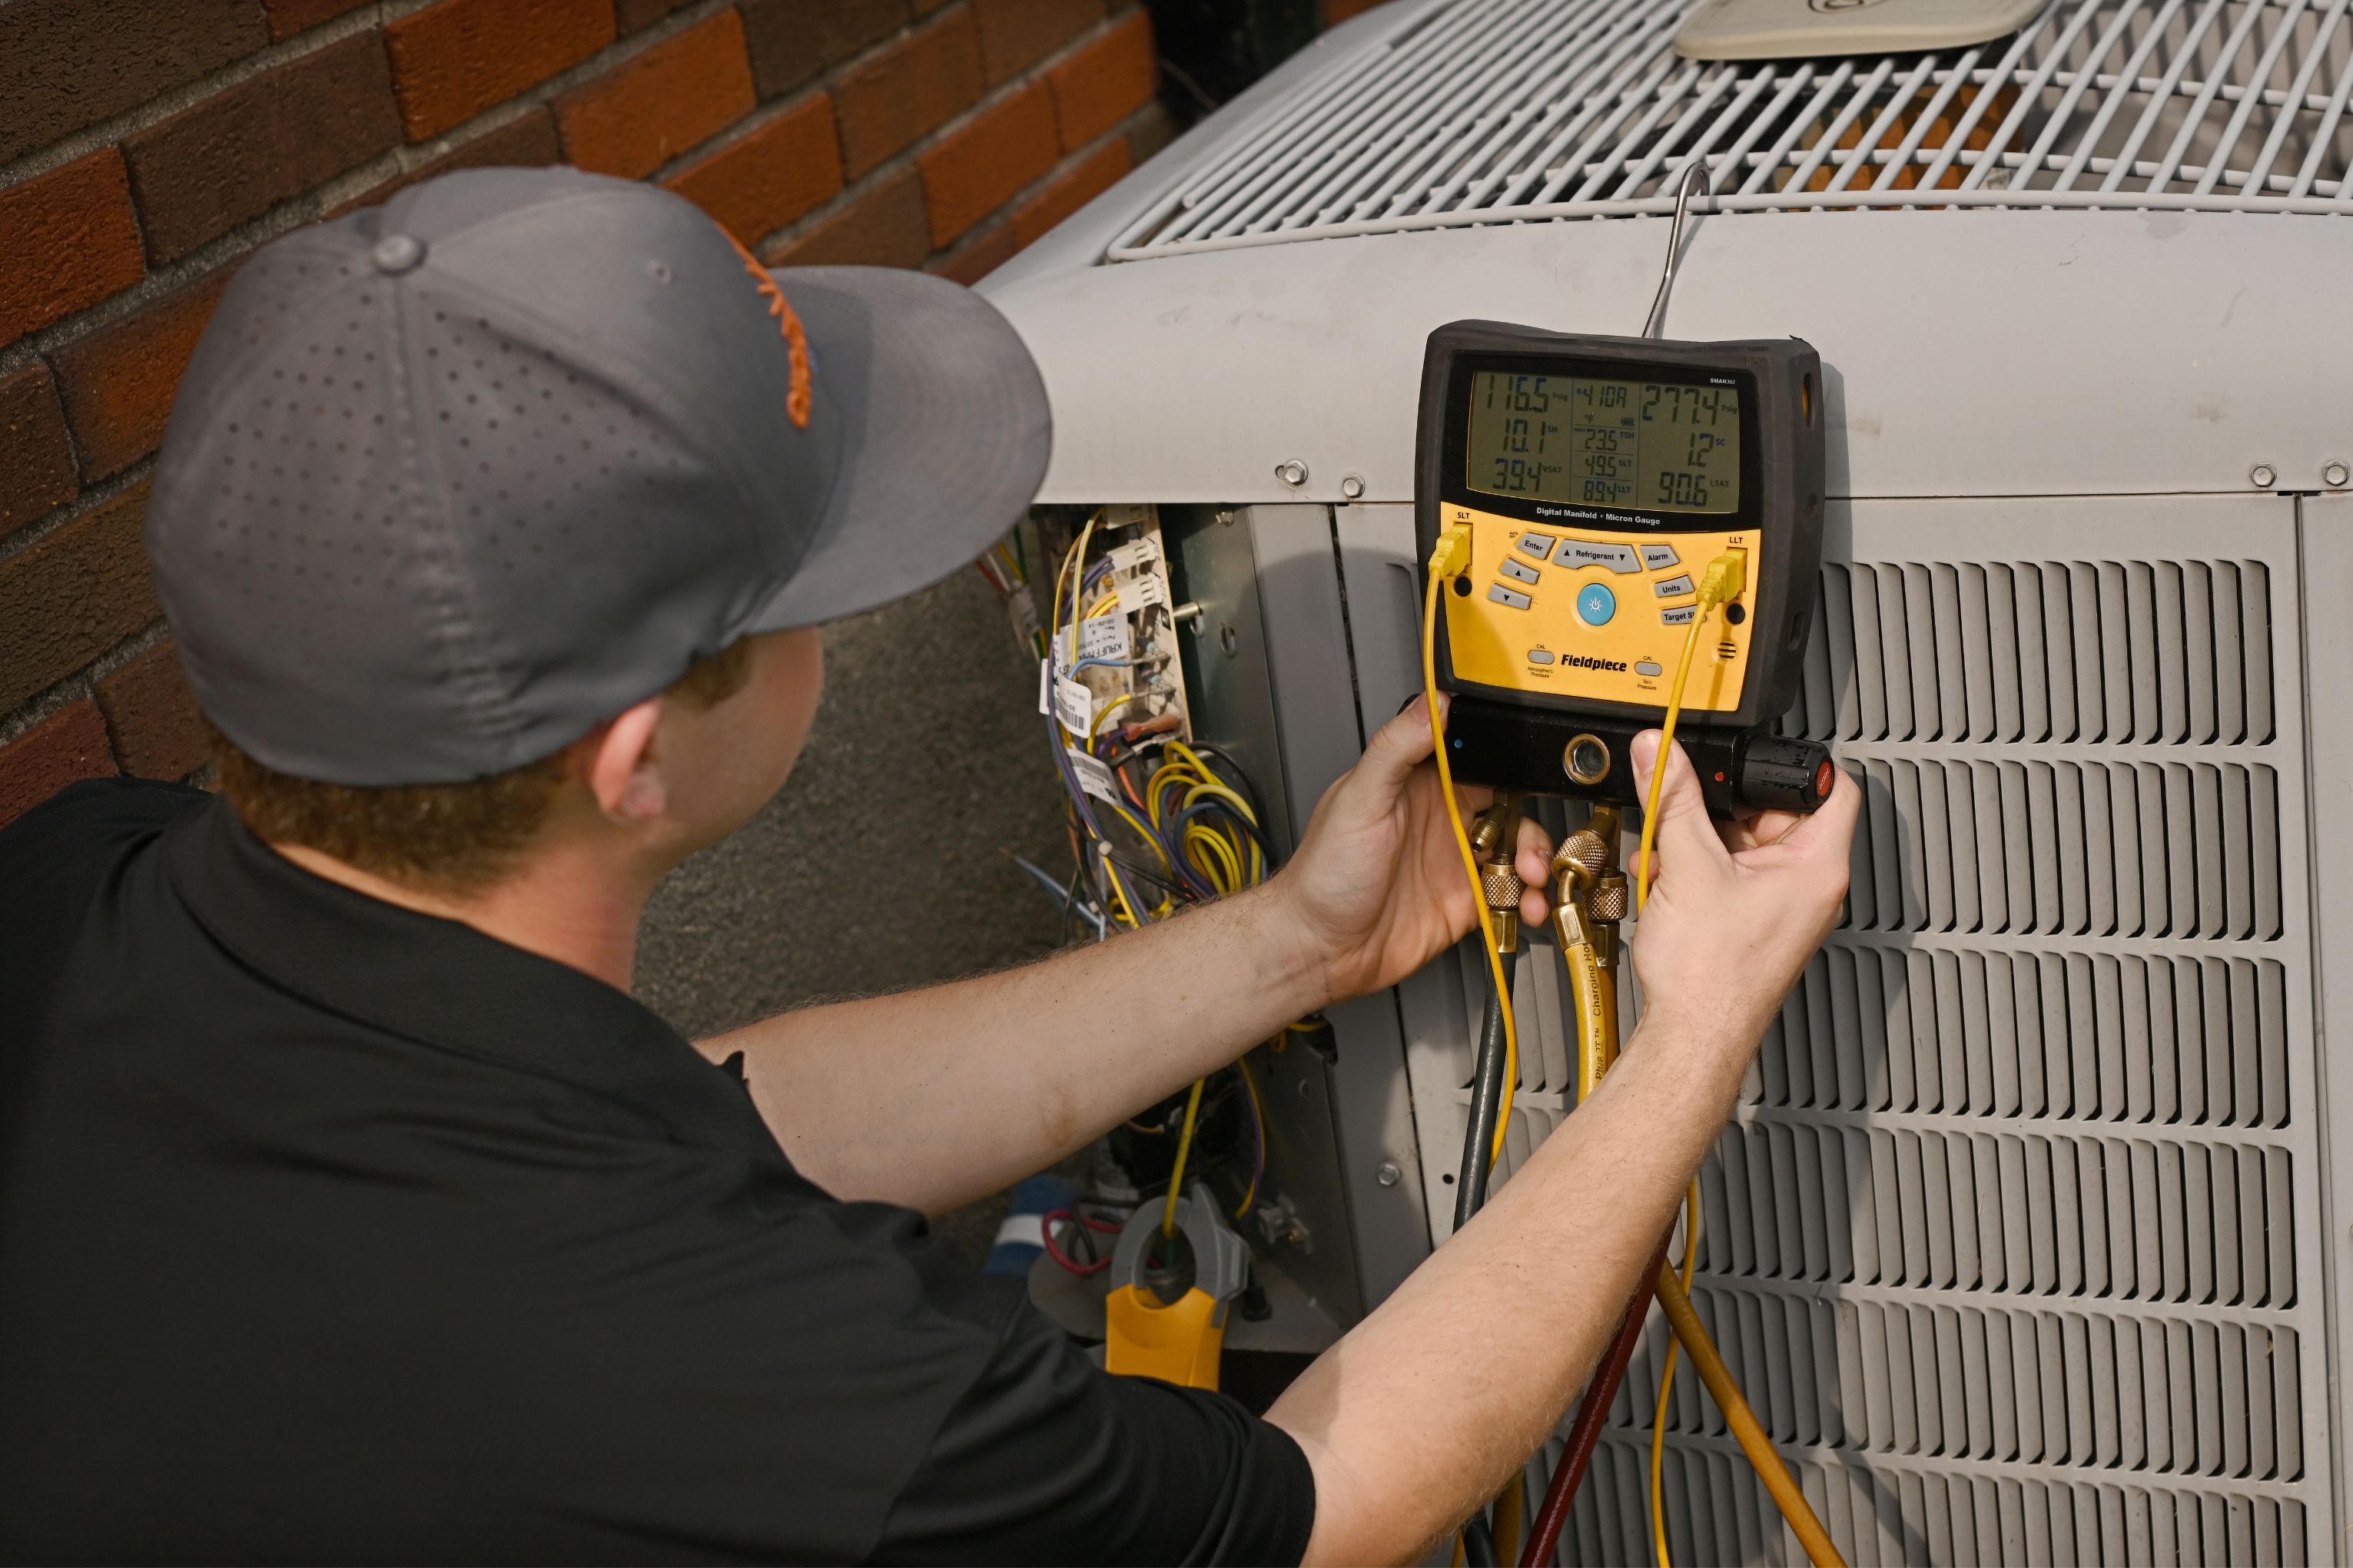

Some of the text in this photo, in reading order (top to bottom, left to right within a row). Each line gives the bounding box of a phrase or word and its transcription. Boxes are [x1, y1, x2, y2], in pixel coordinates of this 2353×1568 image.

[1487, 375, 1568, 413] 116.5 Psig
[1642, 385, 1737, 426] 277.4 Psig
[1503, 419, 1546, 454] 10.1
[1688, 432, 1714, 467] 1.2
[1658, 471, 1730, 506] 90.6 LSAT
[1537, 507, 1561, 515] Digital
[1564, 509, 1598, 519] Manifold
[1606, 513, 1633, 522] Micron
[1634, 516, 1661, 525] Gauge
[1525, 539, 1543, 552] Enter
[1576, 550, 1615, 560] Refrigerant
[1648, 553, 1668, 562] Alarm
[1664, 613, 1687, 622] Target
[1561, 654, 1627, 672] Fieldpiece
[1820, 768, 1830, 790] HIGH
[1589, 965, 1601, 1017] Charging
